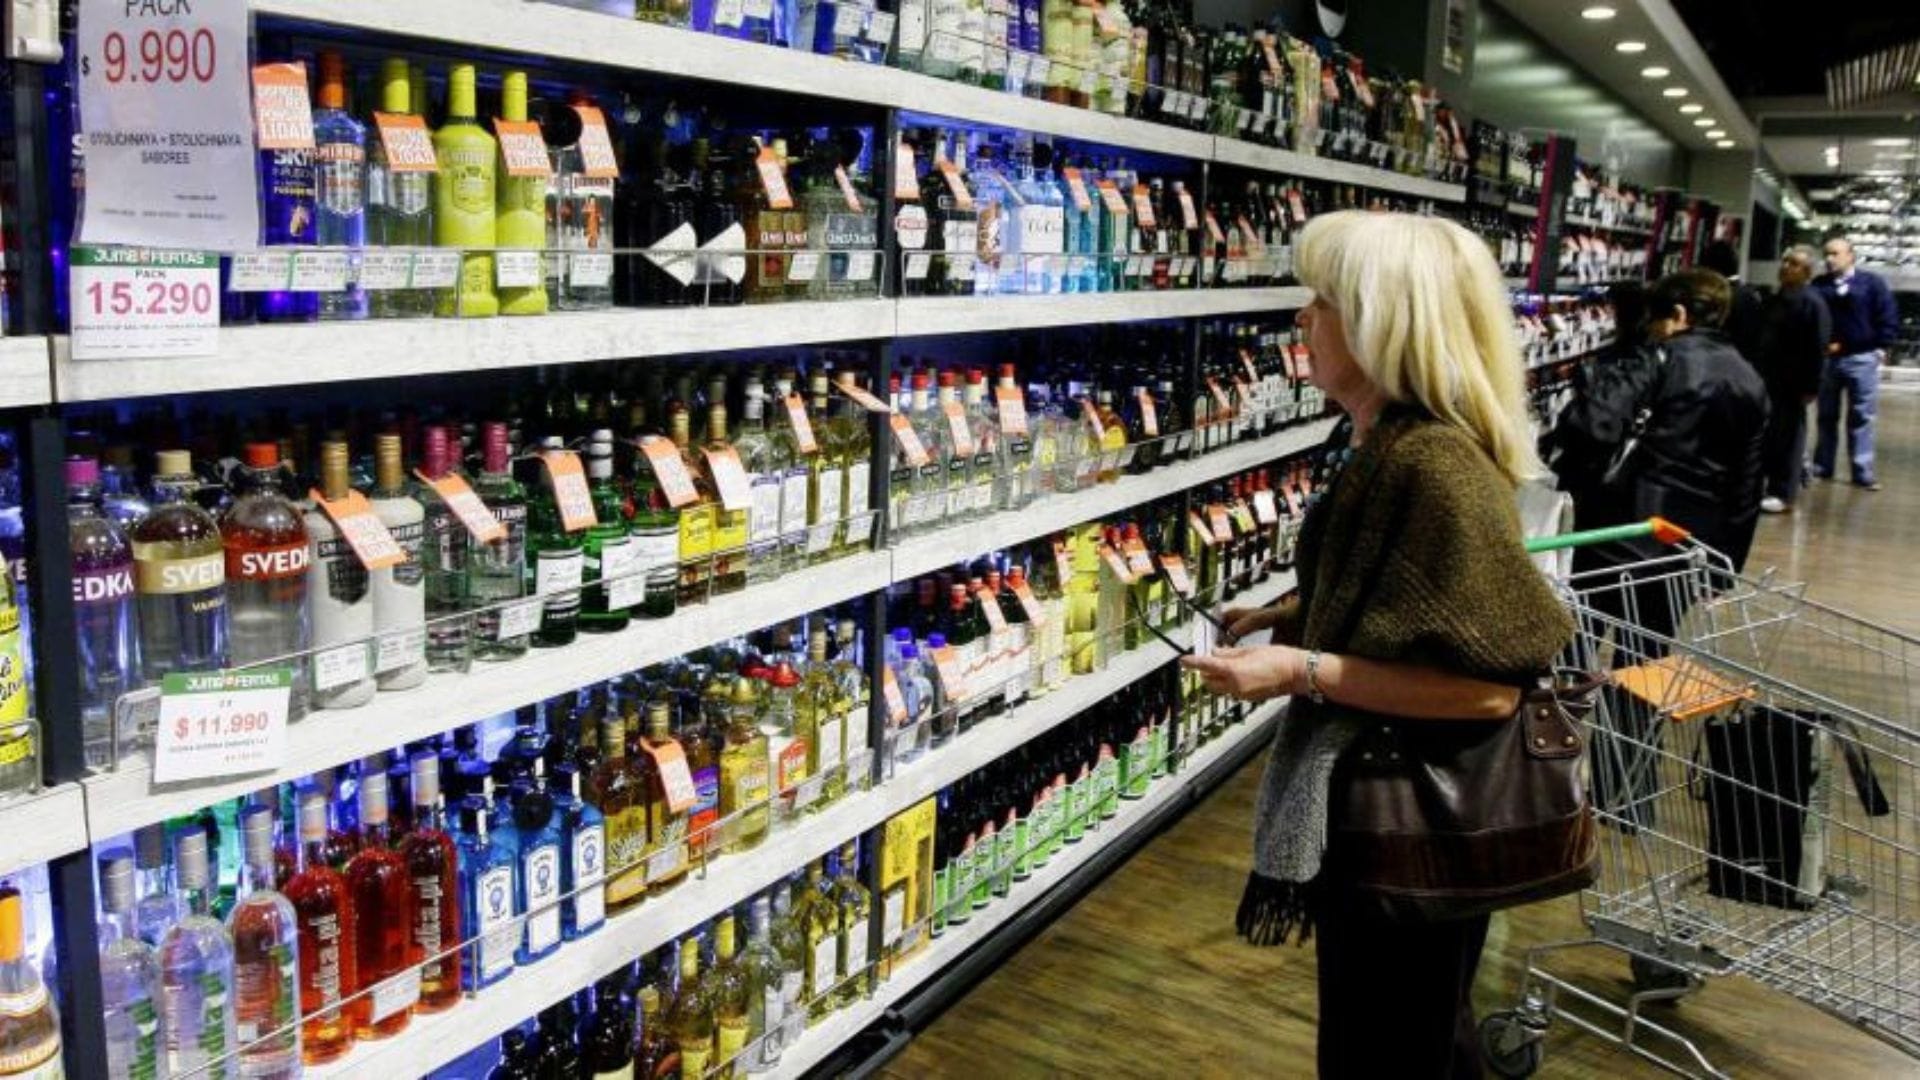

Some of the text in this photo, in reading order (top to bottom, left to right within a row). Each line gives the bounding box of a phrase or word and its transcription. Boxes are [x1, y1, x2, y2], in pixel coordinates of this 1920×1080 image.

[125, 0, 191, 17] PACK
[81, 28, 216, 83] $ 9.990
[135, 270, 166, 279] PACK
[87, 281, 212, 315] 15.290
[72, 571, 134, 602] EDKA
[162, 558, 224, 588] SVED
[174, 717, 189, 740] $
